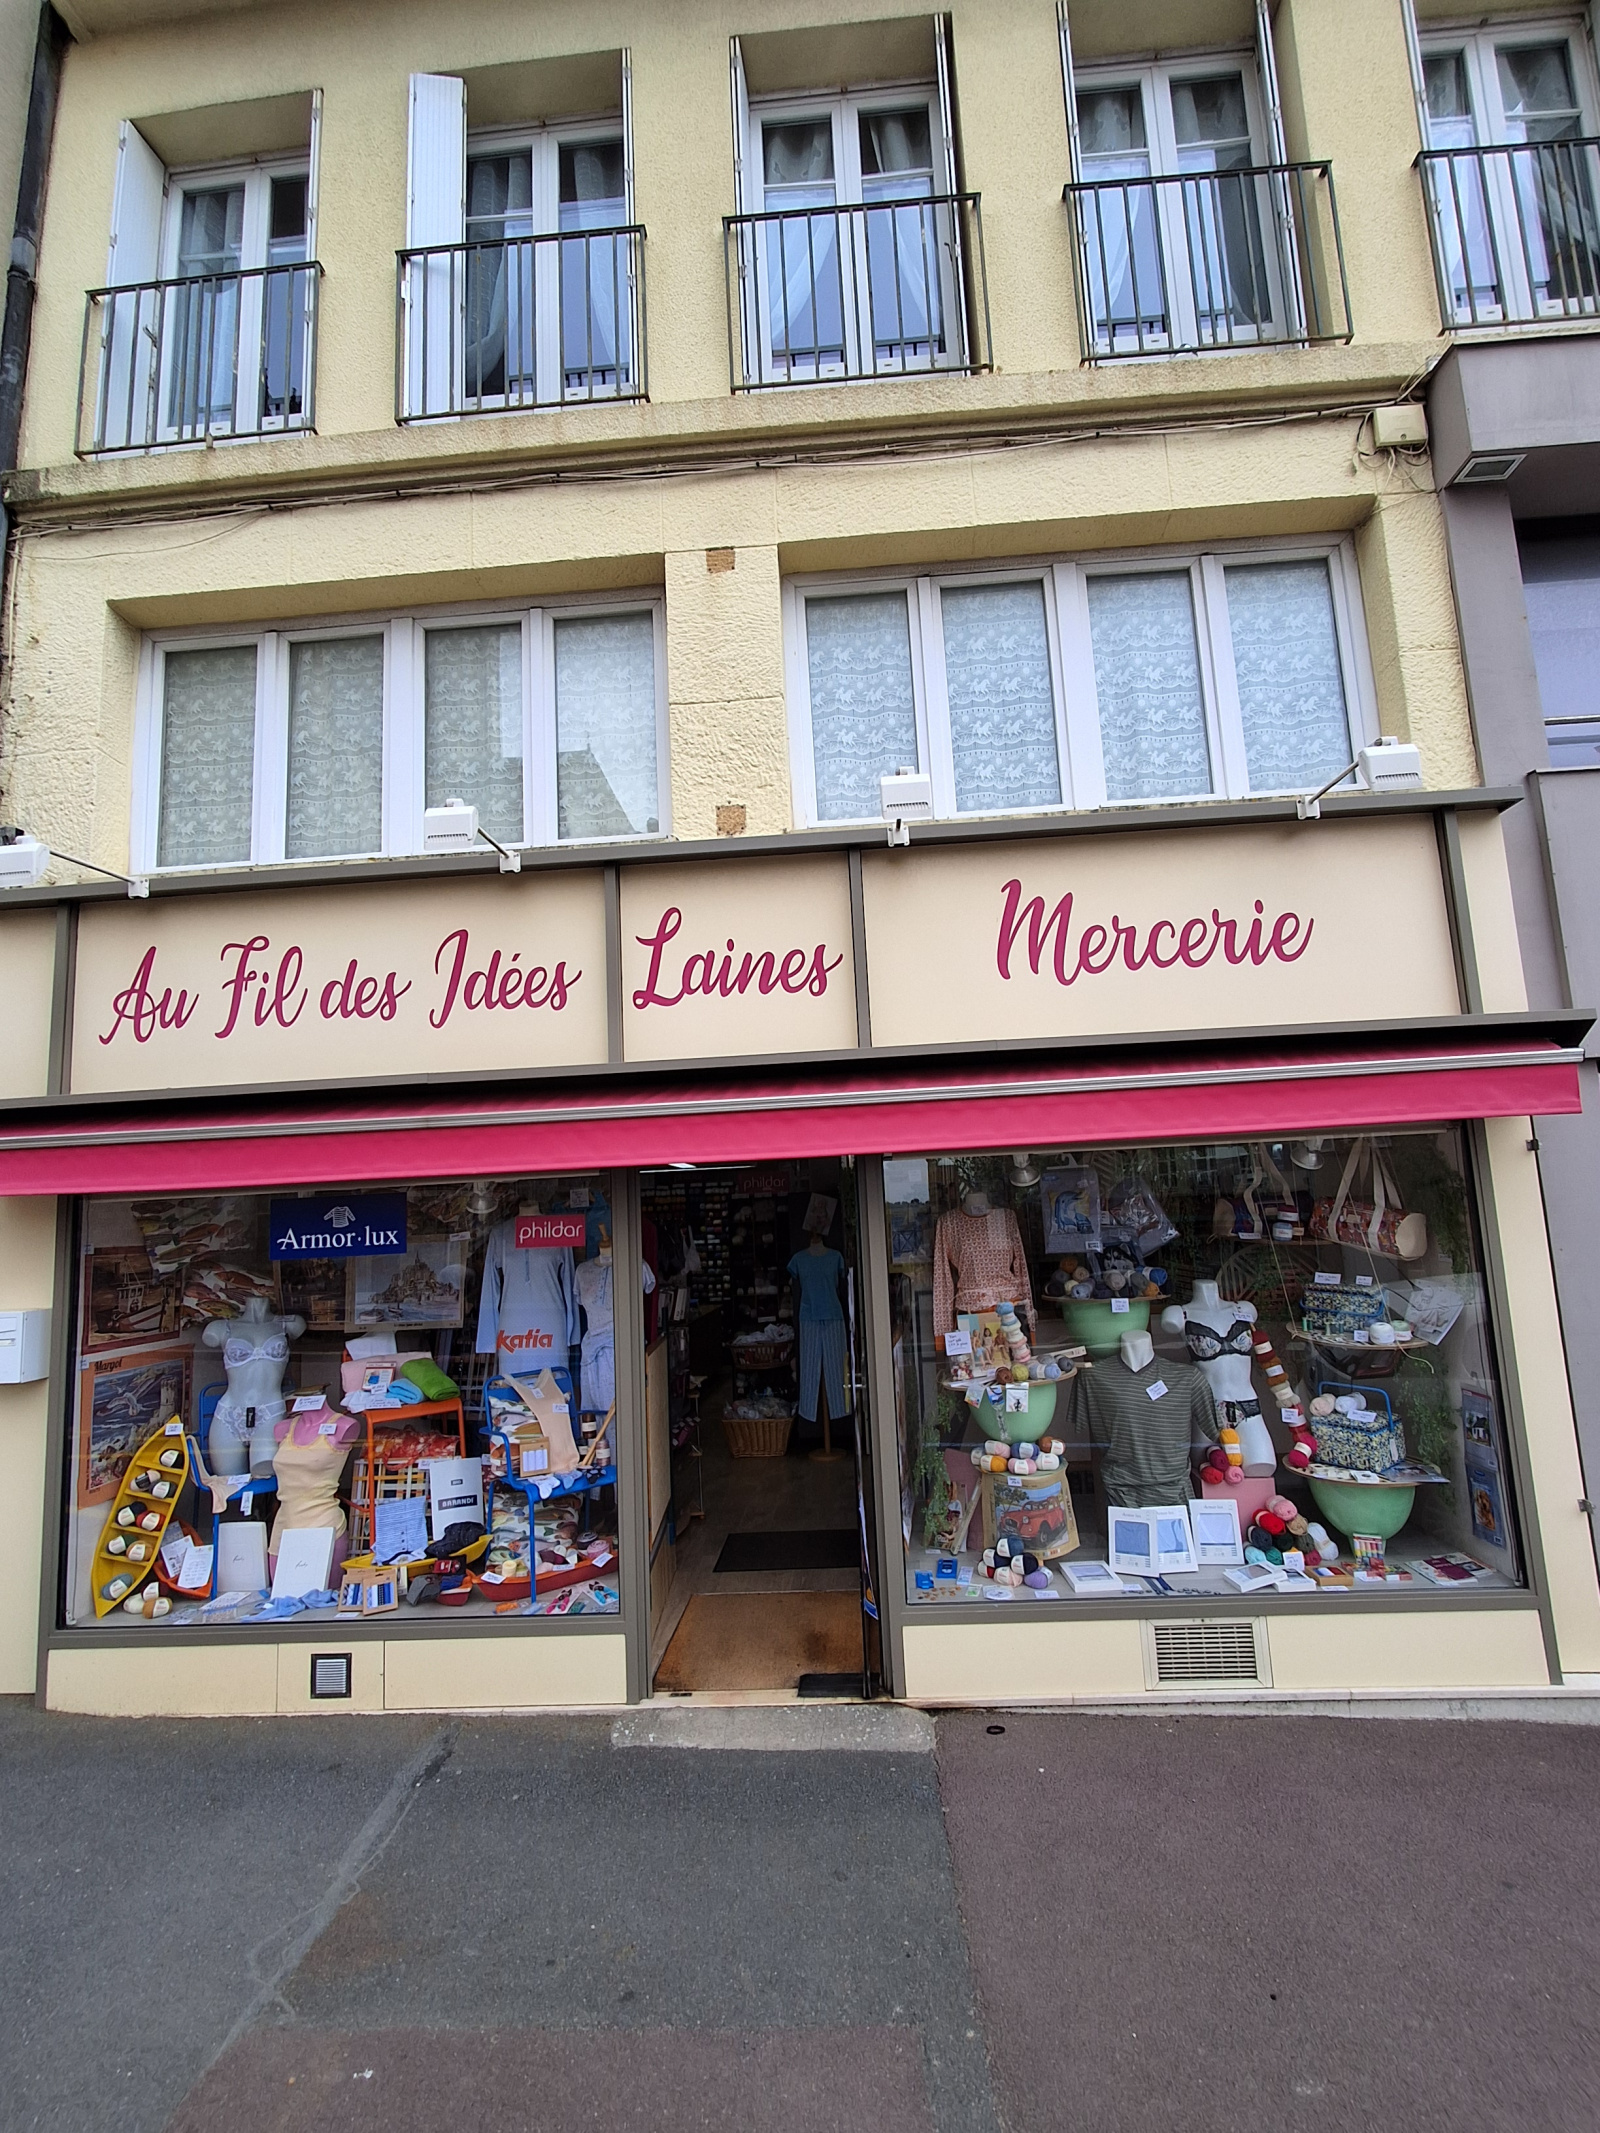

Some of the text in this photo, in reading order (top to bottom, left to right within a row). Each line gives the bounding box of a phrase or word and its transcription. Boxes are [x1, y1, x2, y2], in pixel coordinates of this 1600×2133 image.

[632, 906, 844, 1010] Laines
[996, 878, 1315, 986] Mercerie
[98, 928, 583, 1046] Au Fil des Idées
[518, 1220, 584, 1244] phildar
[495, 1328, 554, 1354] katia
